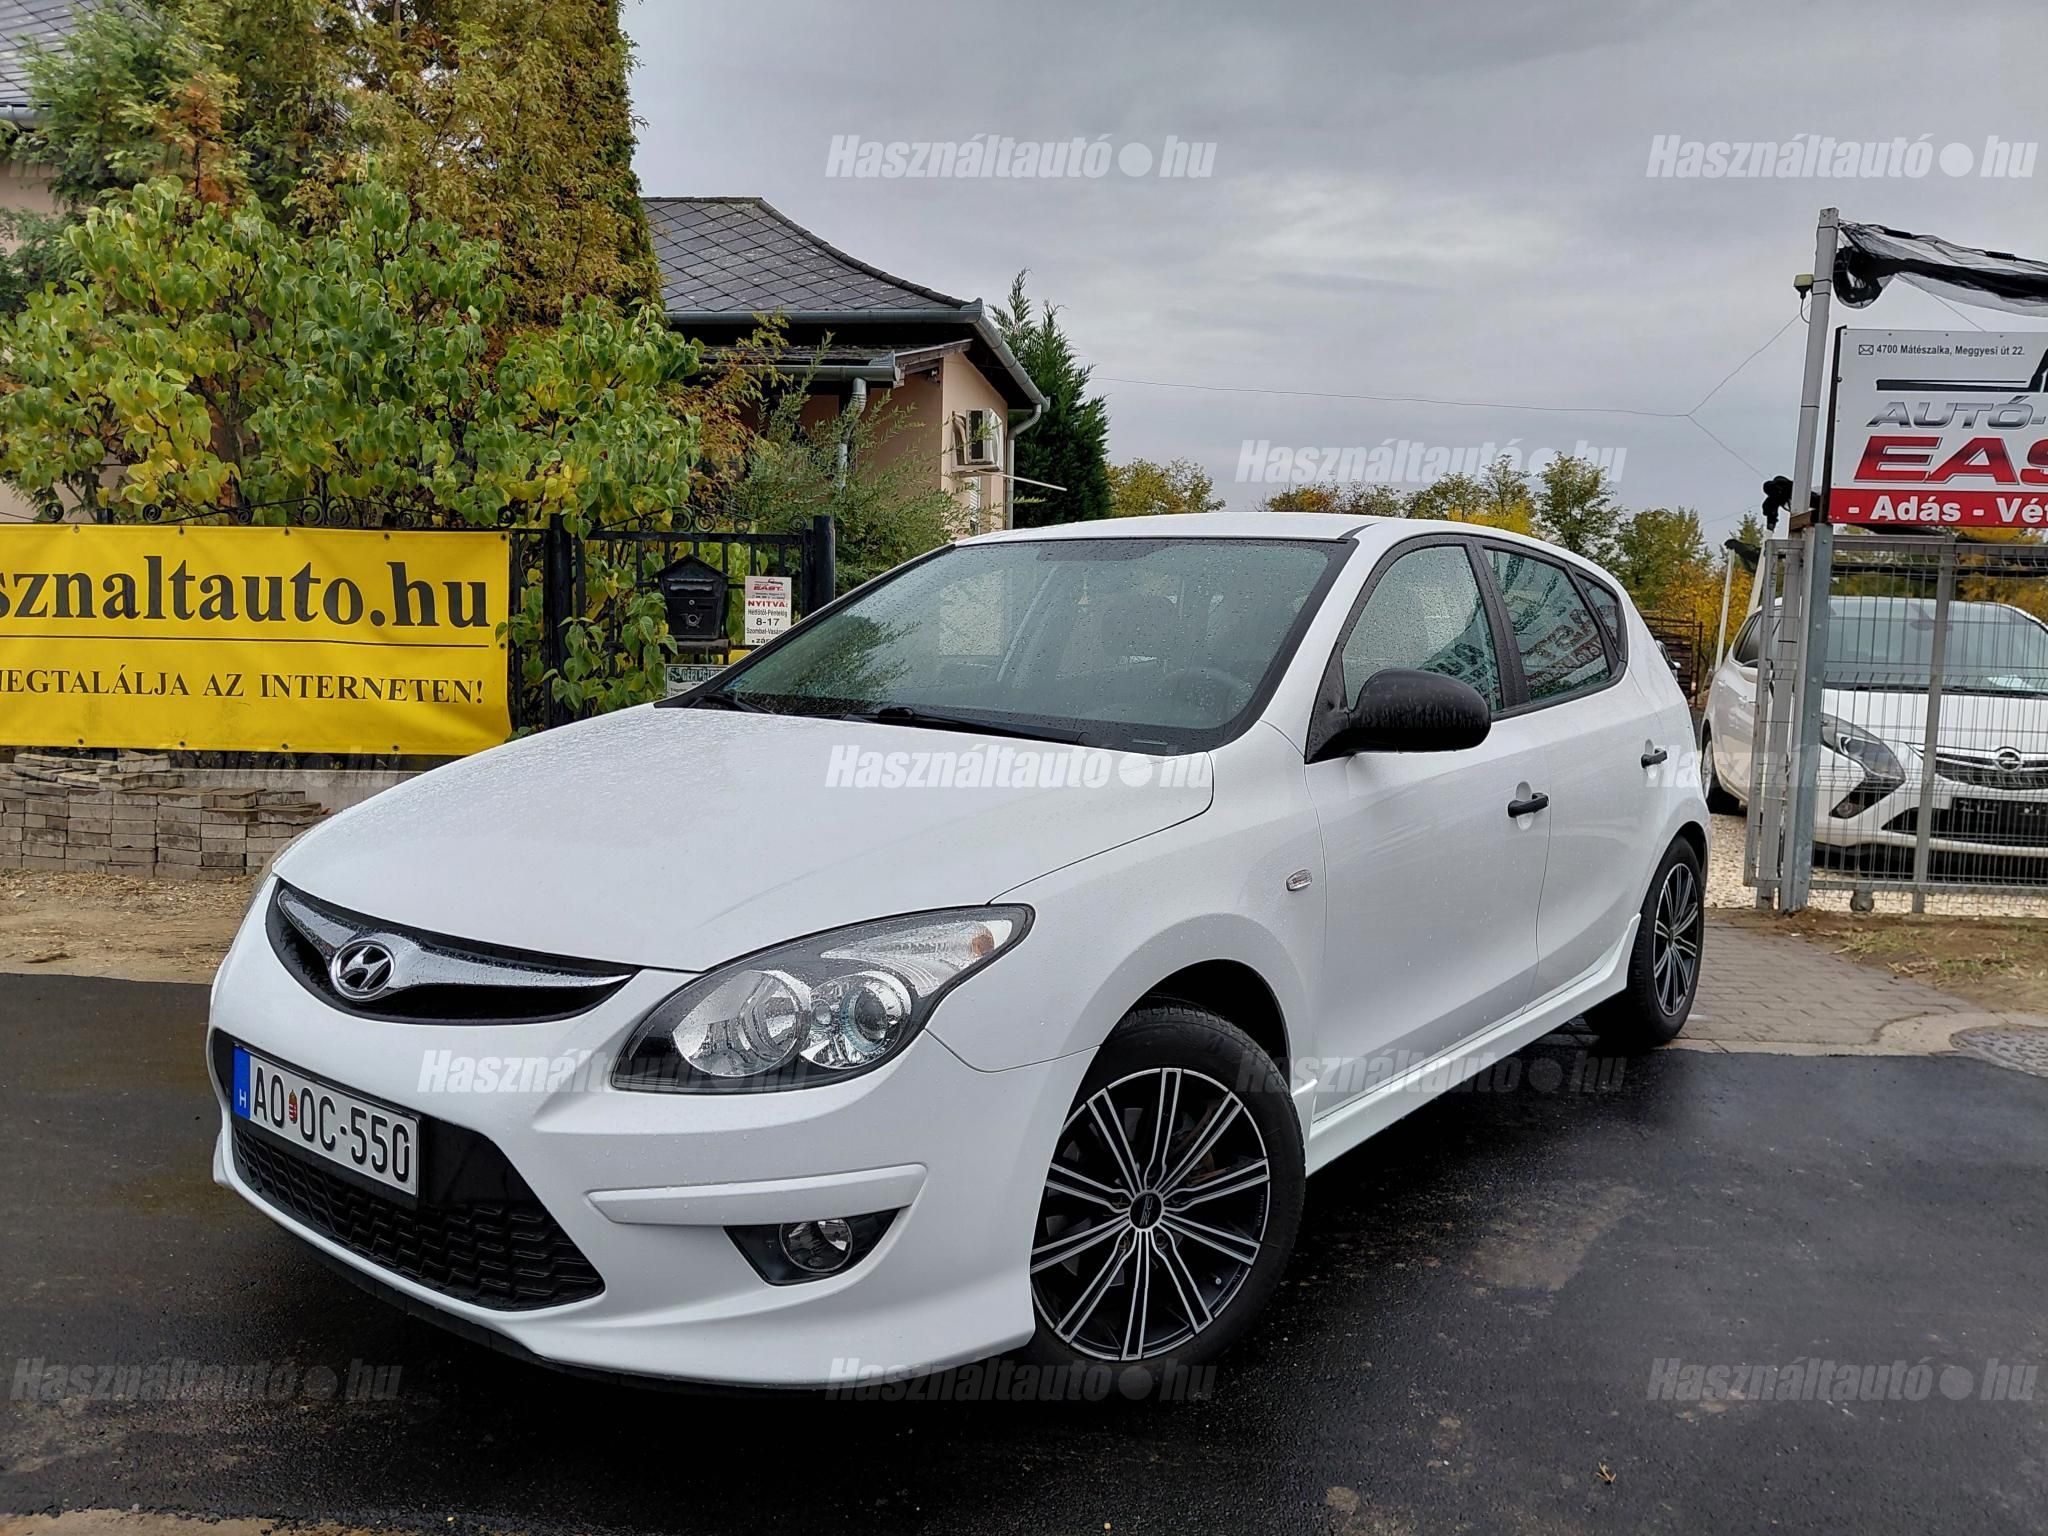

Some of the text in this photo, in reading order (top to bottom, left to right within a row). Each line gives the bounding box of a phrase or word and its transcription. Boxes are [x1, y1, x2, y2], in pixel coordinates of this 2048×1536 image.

[1876, 344, 1898, 354] 4700
[1955, 346, 1999, 357] Meggyesi
[2000, 346, 2010, 355] út
[2012, 346, 2025, 356] 22.
[1870, 496, 1961, 522] Adás
[756, 617, 780, 626] 8-17
[0, 664, 484, 705] EGTALÁLJA AZ INTERNETEN!
